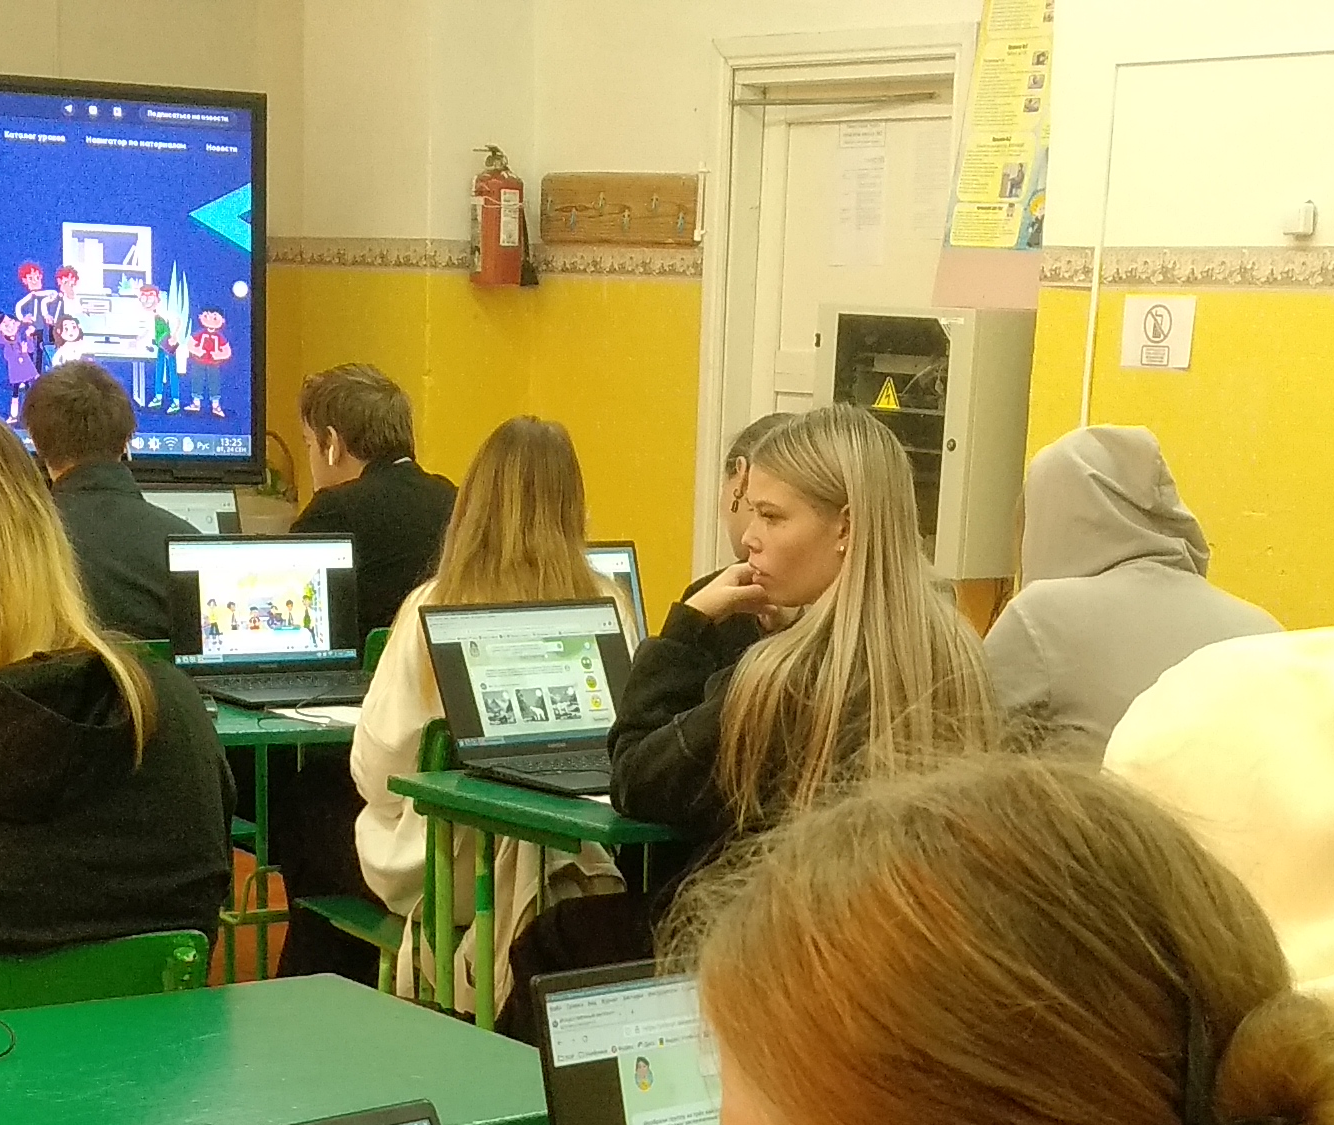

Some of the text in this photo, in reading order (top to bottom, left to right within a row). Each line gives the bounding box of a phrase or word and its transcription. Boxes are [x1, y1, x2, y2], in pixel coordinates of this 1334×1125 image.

[147, 109, 191, 120] Подписаться
[201, 114, 230, 123] новости
[4, 130, 66, 143] Каталог уроков
[85, 135, 128, 148] Навигатор
[139, 140, 187, 151] материалам
[205, 143, 239, 154] Новости
[196, 441, 210, 450] Рус
[220, 438, 243, 447] 13:25
